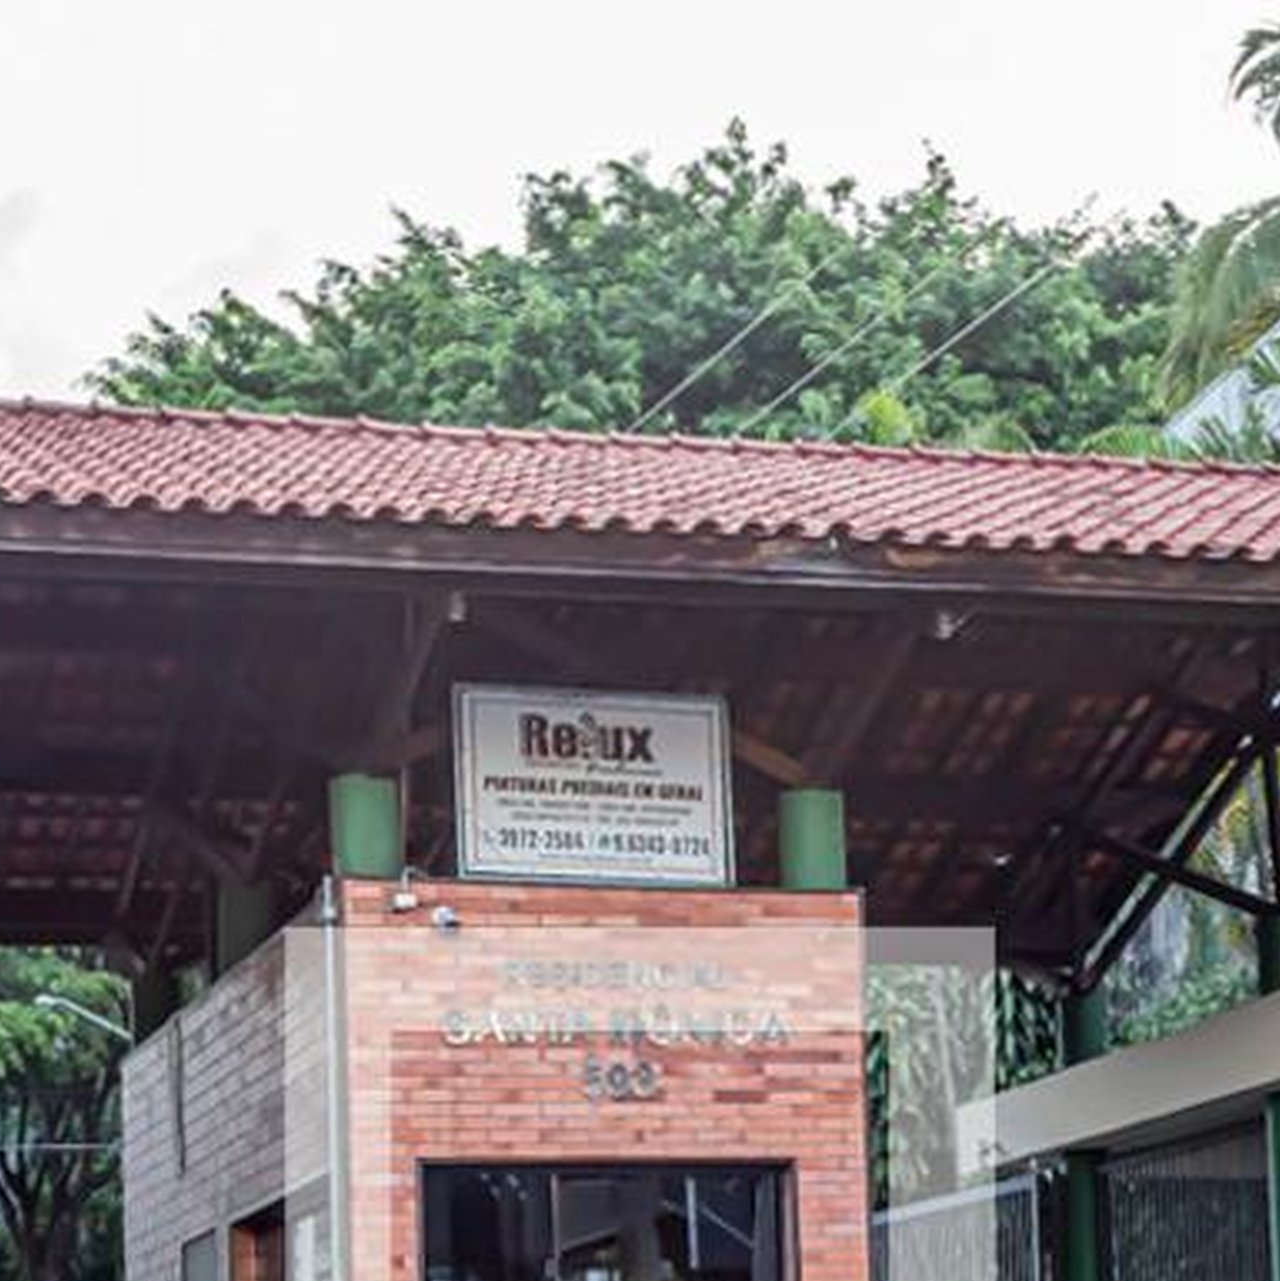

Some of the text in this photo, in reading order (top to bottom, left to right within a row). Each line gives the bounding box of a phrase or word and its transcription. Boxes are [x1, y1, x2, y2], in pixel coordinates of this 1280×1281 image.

[634, 783, 655, 799] EM
[659, 785, 704, 801] GERAL
[440, 1006, 590, 1046] SANTA
